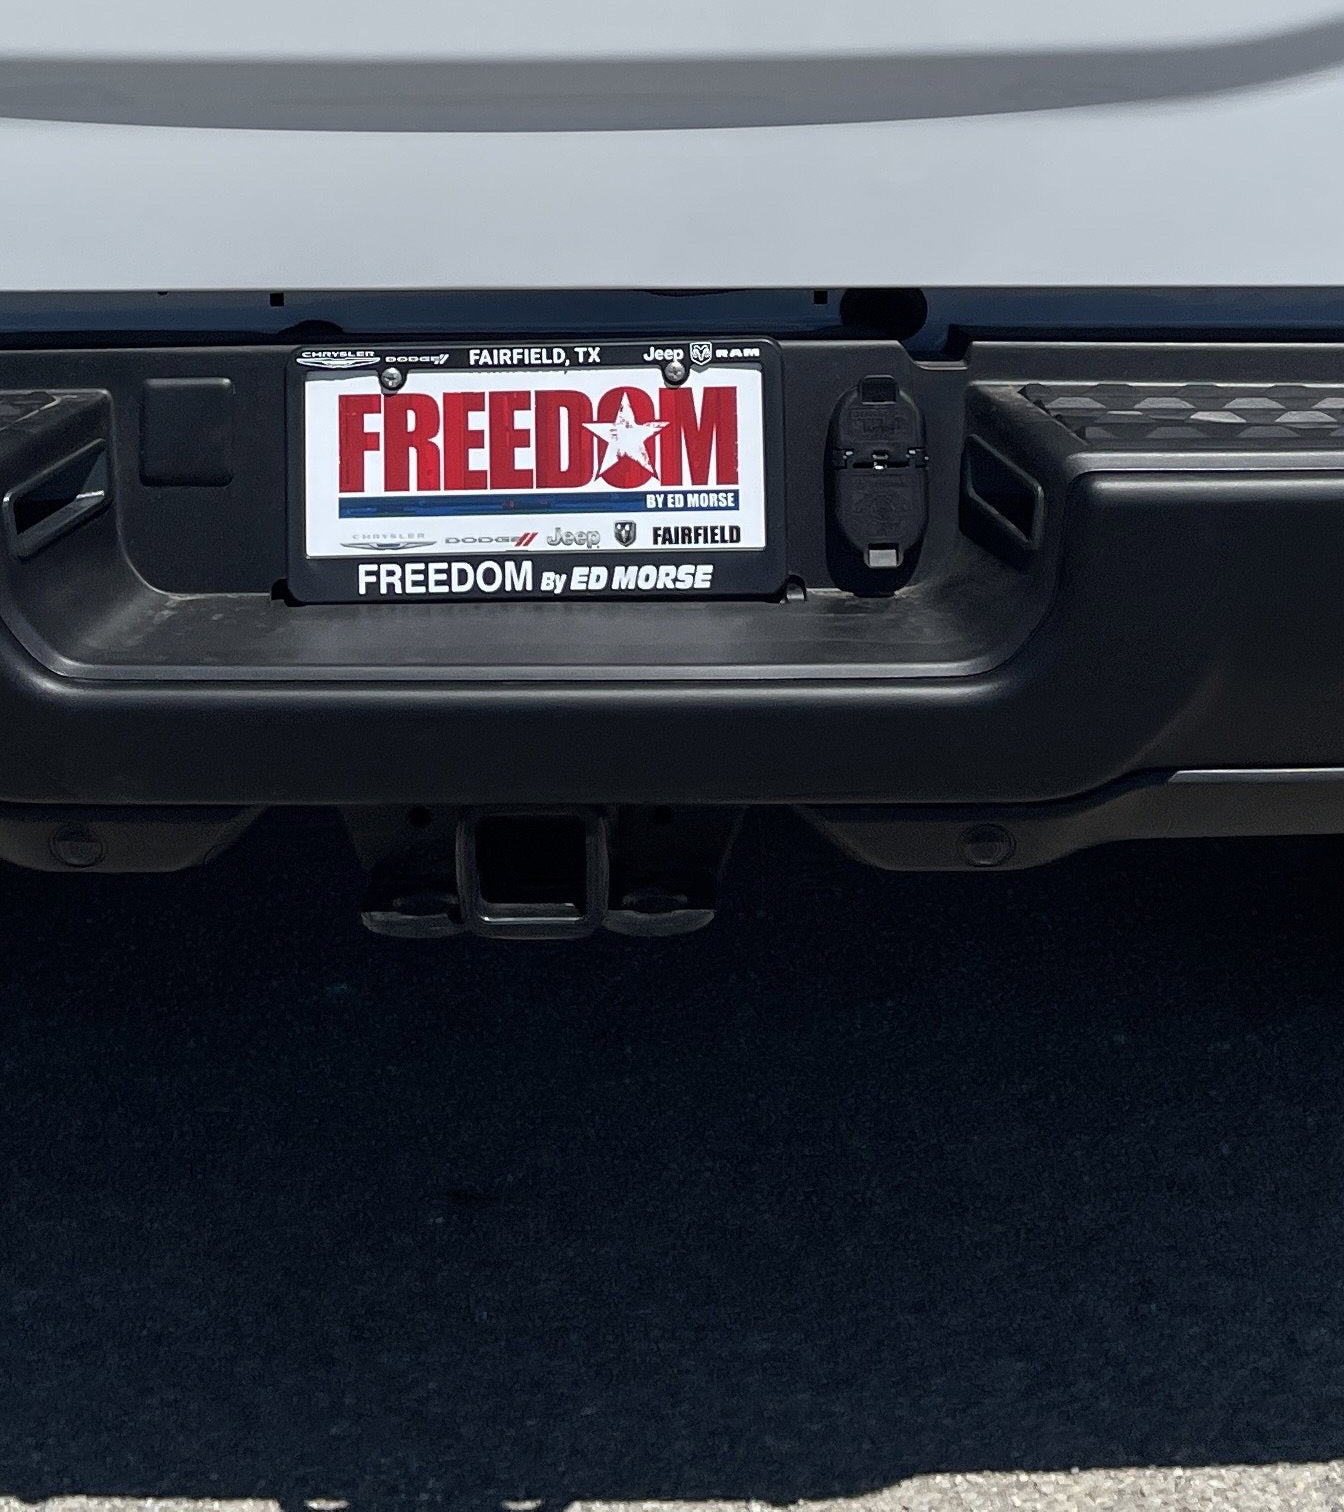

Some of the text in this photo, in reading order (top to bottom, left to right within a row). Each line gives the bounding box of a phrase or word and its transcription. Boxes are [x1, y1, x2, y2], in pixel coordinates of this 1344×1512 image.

[469, 347, 601, 366] FAIRFIELD, TX
[643, 347, 684, 363] Jeep
[716, 347, 760, 358] RAM
[338, 386, 739, 493] FREEDOM
[646, 492, 735, 509] BY ED MORSE
[445, 536, 518, 544] DODGE
[546, 527, 601, 548] Jeep
[653, 525, 741, 545] FAIRFIELD
[358, 560, 714, 595] FREEDOM By ED MORSE
